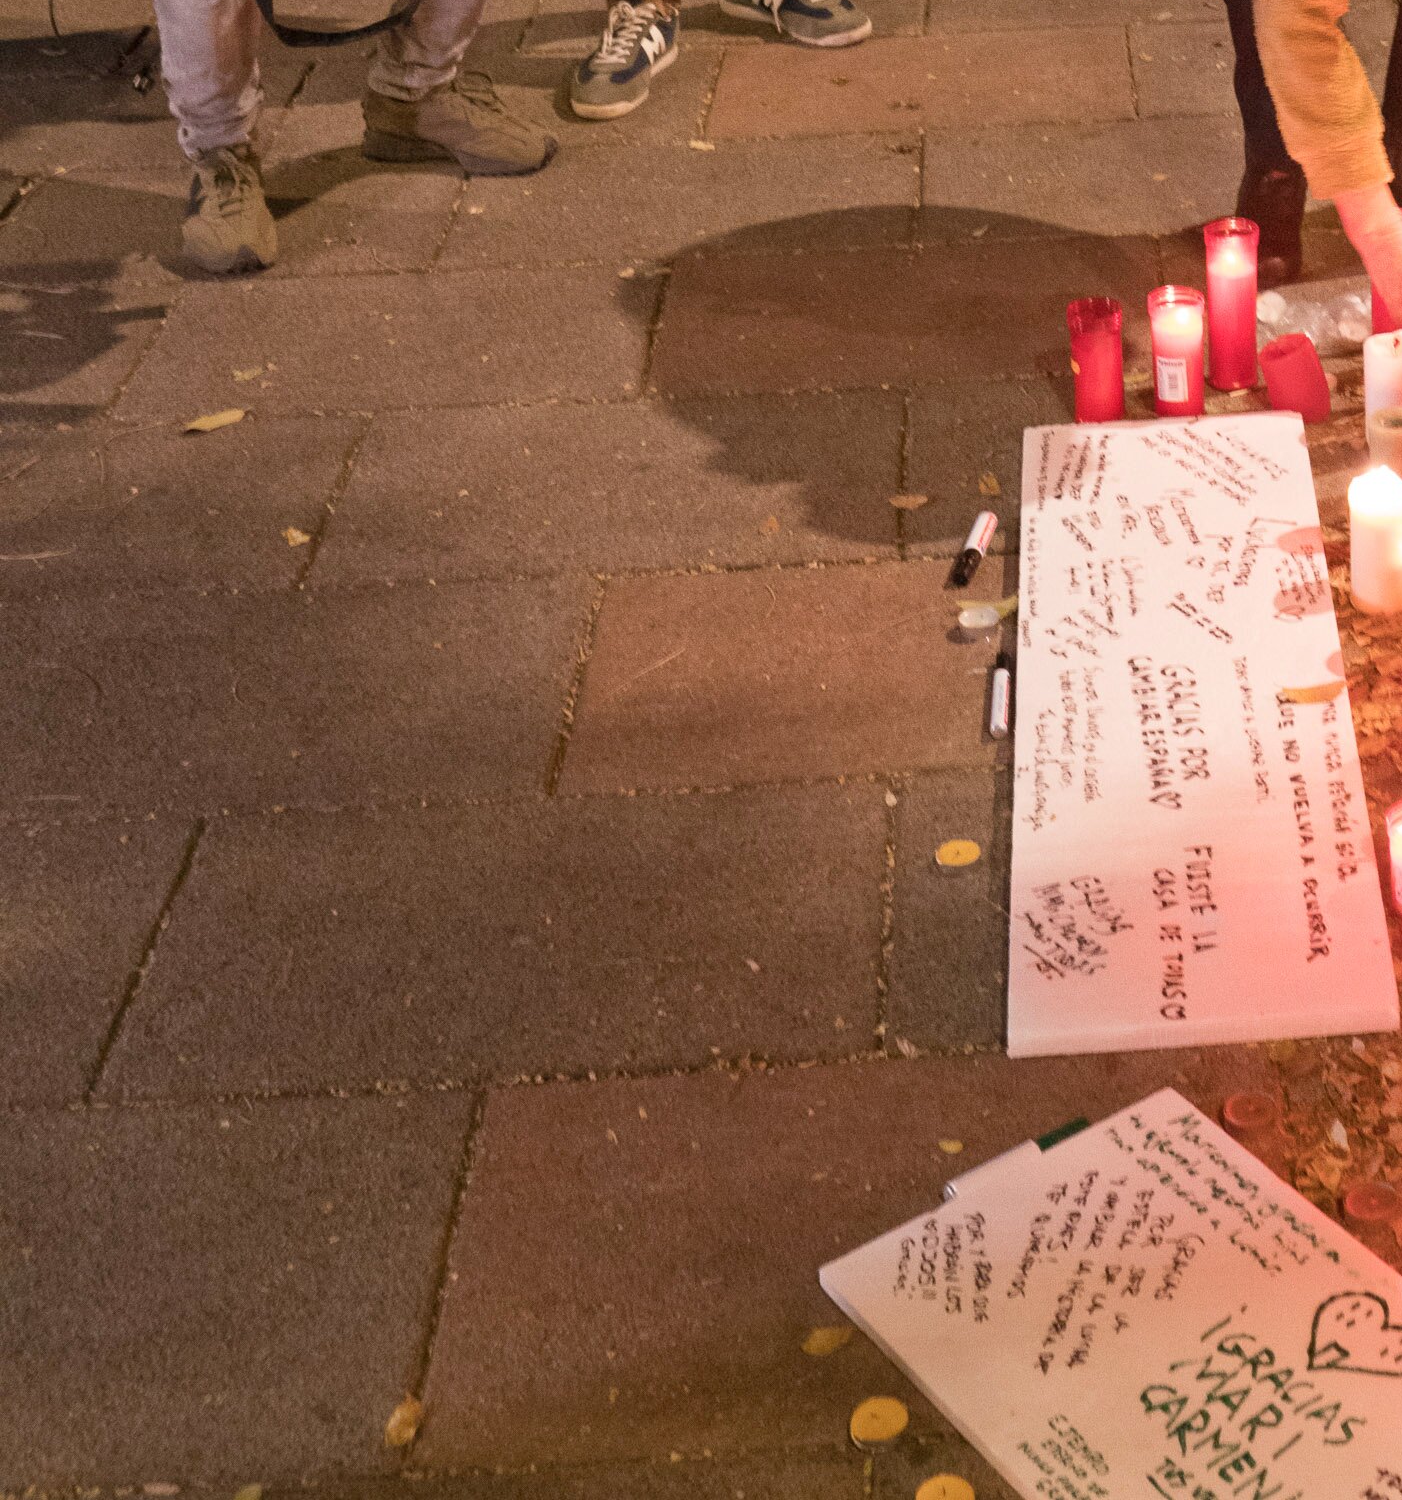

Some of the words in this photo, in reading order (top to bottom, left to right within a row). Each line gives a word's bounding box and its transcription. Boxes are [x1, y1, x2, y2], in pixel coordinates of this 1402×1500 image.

[1126, 656, 1161, 725] CAMBIAR
[1160, 665, 1205, 736] GRACIAS
[1180, 747, 1211, 781] POR
[1282, 738, 1301, 764] NO
[1289, 773, 1314, 847] VUELVA
[1300, 855, 1316, 867] A
[1152, 868, 1178, 911] CASA
